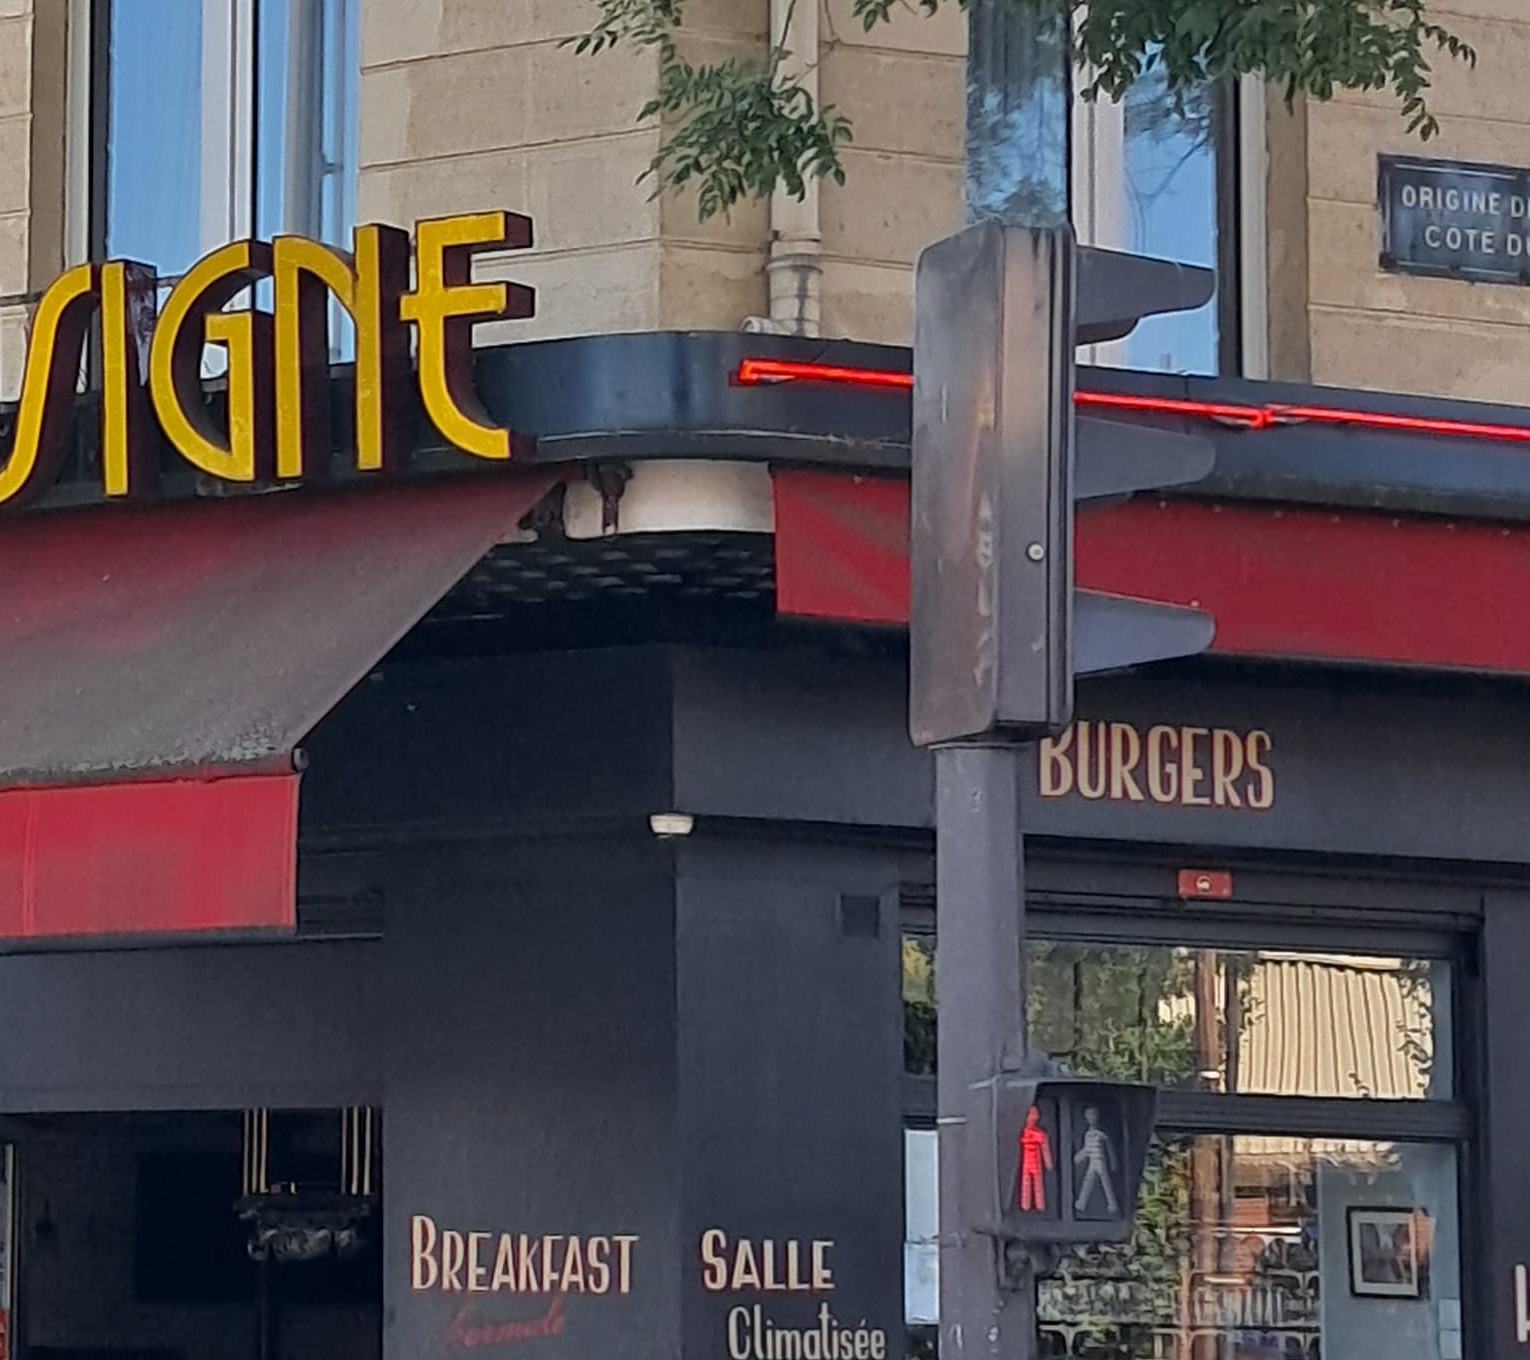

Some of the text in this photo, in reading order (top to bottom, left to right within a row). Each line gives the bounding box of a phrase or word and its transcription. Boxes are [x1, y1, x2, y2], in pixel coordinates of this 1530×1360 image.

[1401, 184, 1530, 219] ORIGINE D
[1506, 233, 1530, 257] D
[1038, 719, 1275, 810] BURGERS
[410, 1215, 639, 1294] BREAKFAST
[701, 1229, 836, 1291] SALLE
[728, 1302, 886, 1360] Climatisée
